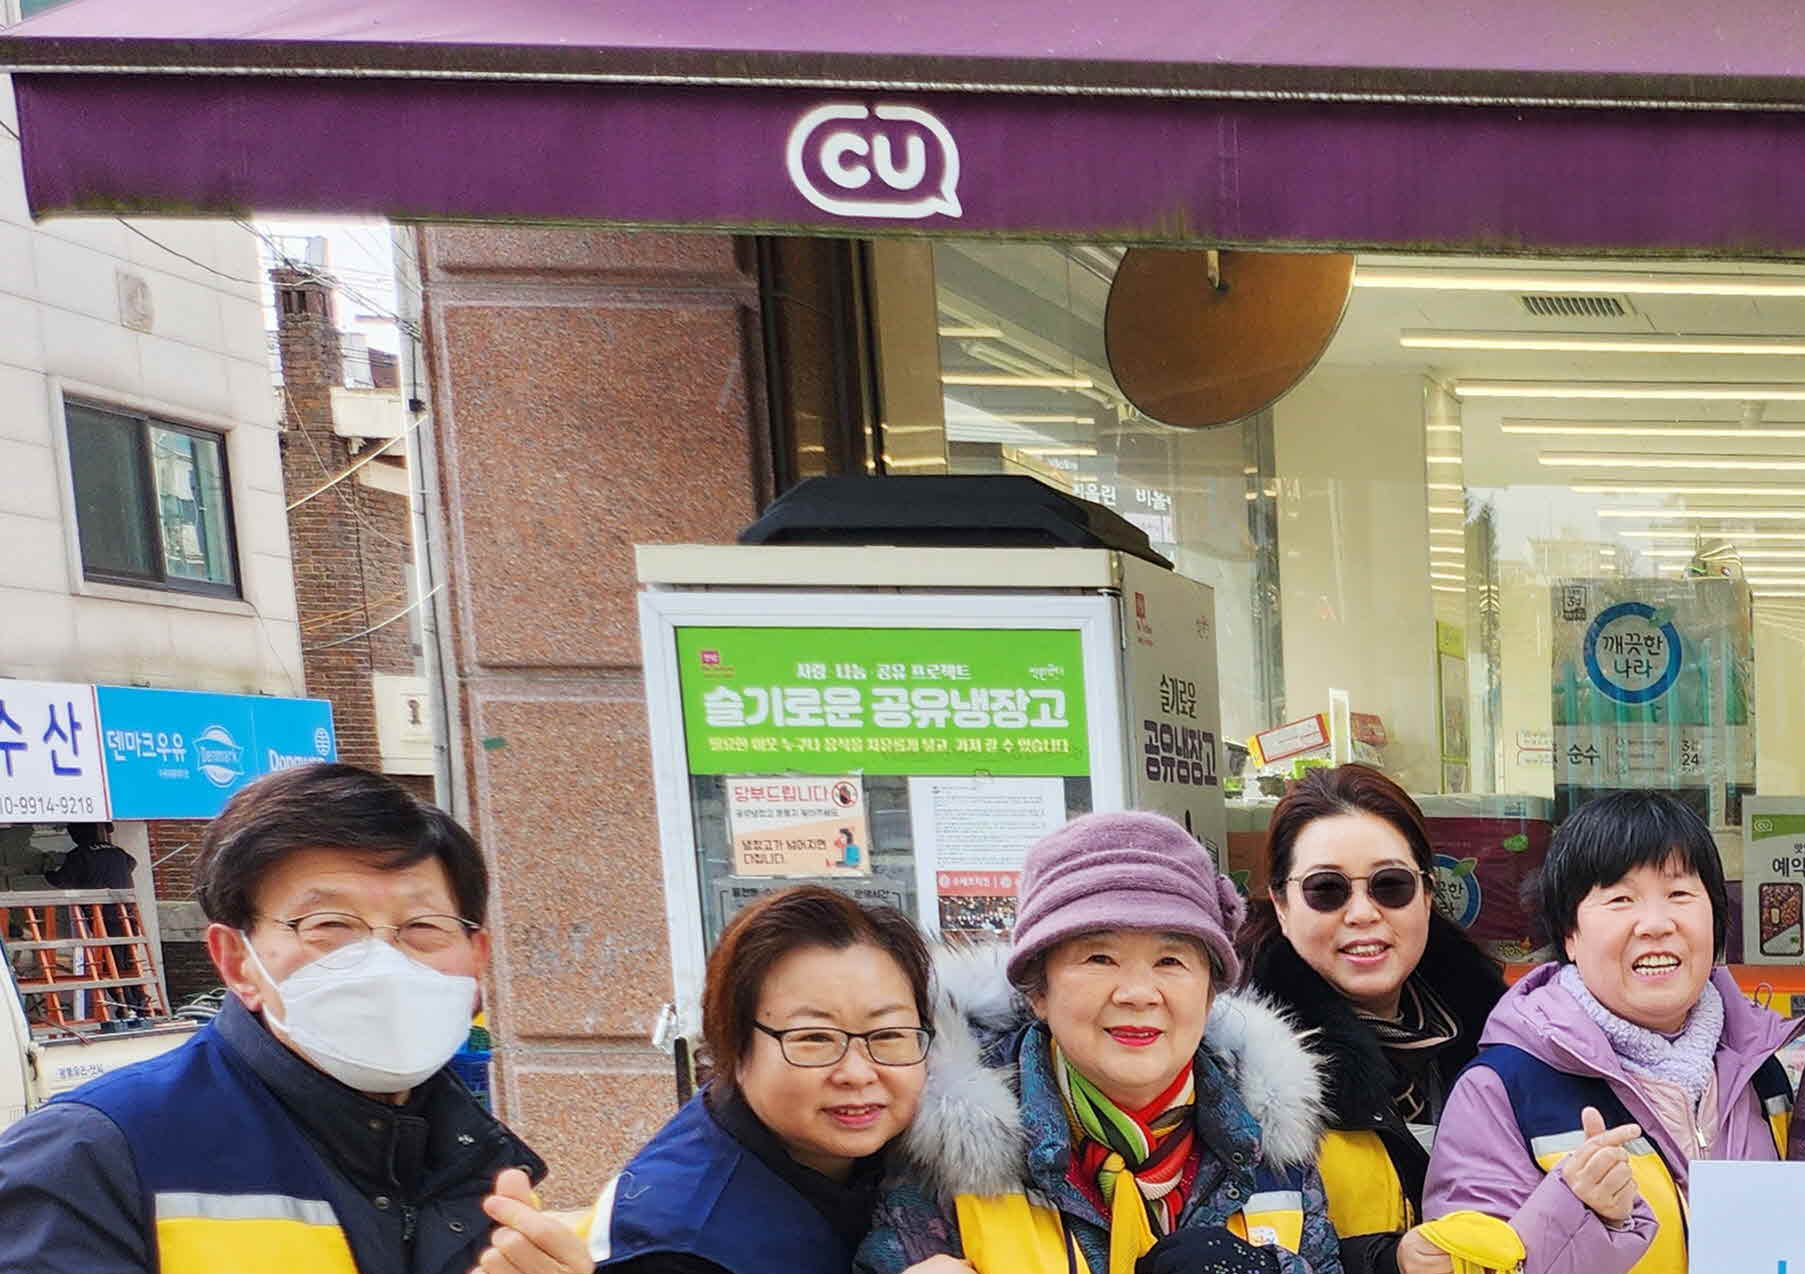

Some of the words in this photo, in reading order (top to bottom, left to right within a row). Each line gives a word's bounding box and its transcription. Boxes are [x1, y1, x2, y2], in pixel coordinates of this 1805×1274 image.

[1602, 633, 1664, 656] 깨끗한
[1614, 658, 1652, 678] 나라
[703, 685, 864, 729] 슬기로운
[871, 686, 1070, 730] 공유냉장고
[1159, 673, 1198, 720] 슬기로운
[106, 730, 187, 763] 덴마크우유
[1144, 719, 1217, 786] 공유냉장고
[1567, 743, 1601, 765] 순수
[735, 784, 833, 803] 당부드립니다
